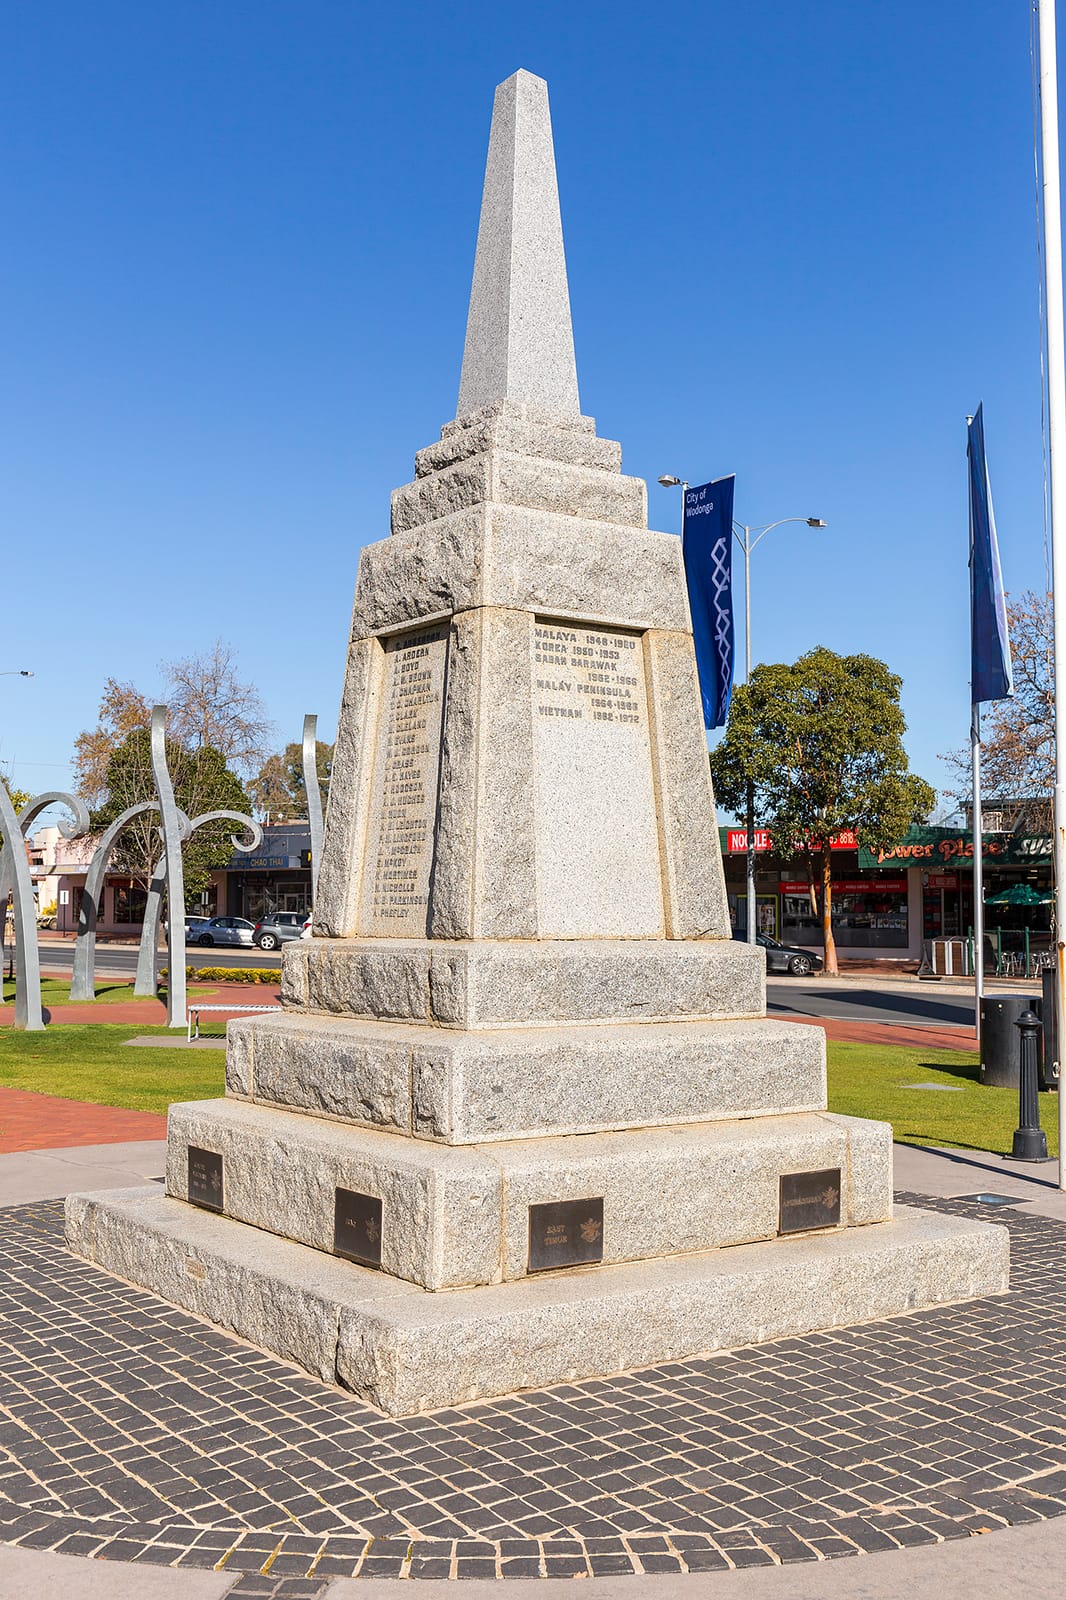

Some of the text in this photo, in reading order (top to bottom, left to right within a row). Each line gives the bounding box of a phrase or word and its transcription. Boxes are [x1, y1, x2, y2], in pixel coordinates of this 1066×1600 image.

[686, 488, 707, 504] City of
[686, 502, 714, 517] Wodonga
[535, 629, 577, 643] MALAYA
[402, 647, 429, 660] ARDERN
[535, 641, 567, 654] KOREA
[401, 662, 419, 671] BOYD
[535, 653, 617, 671] SABAH SARAWAK
[536, 679, 631, 698] MALAY PENINSULA
[538, 705, 582, 718] VIETNAM
[938, 838, 1002, 862] Place
[250, 858, 268, 867] CHAO
[269, 858, 284, 867] THAI
